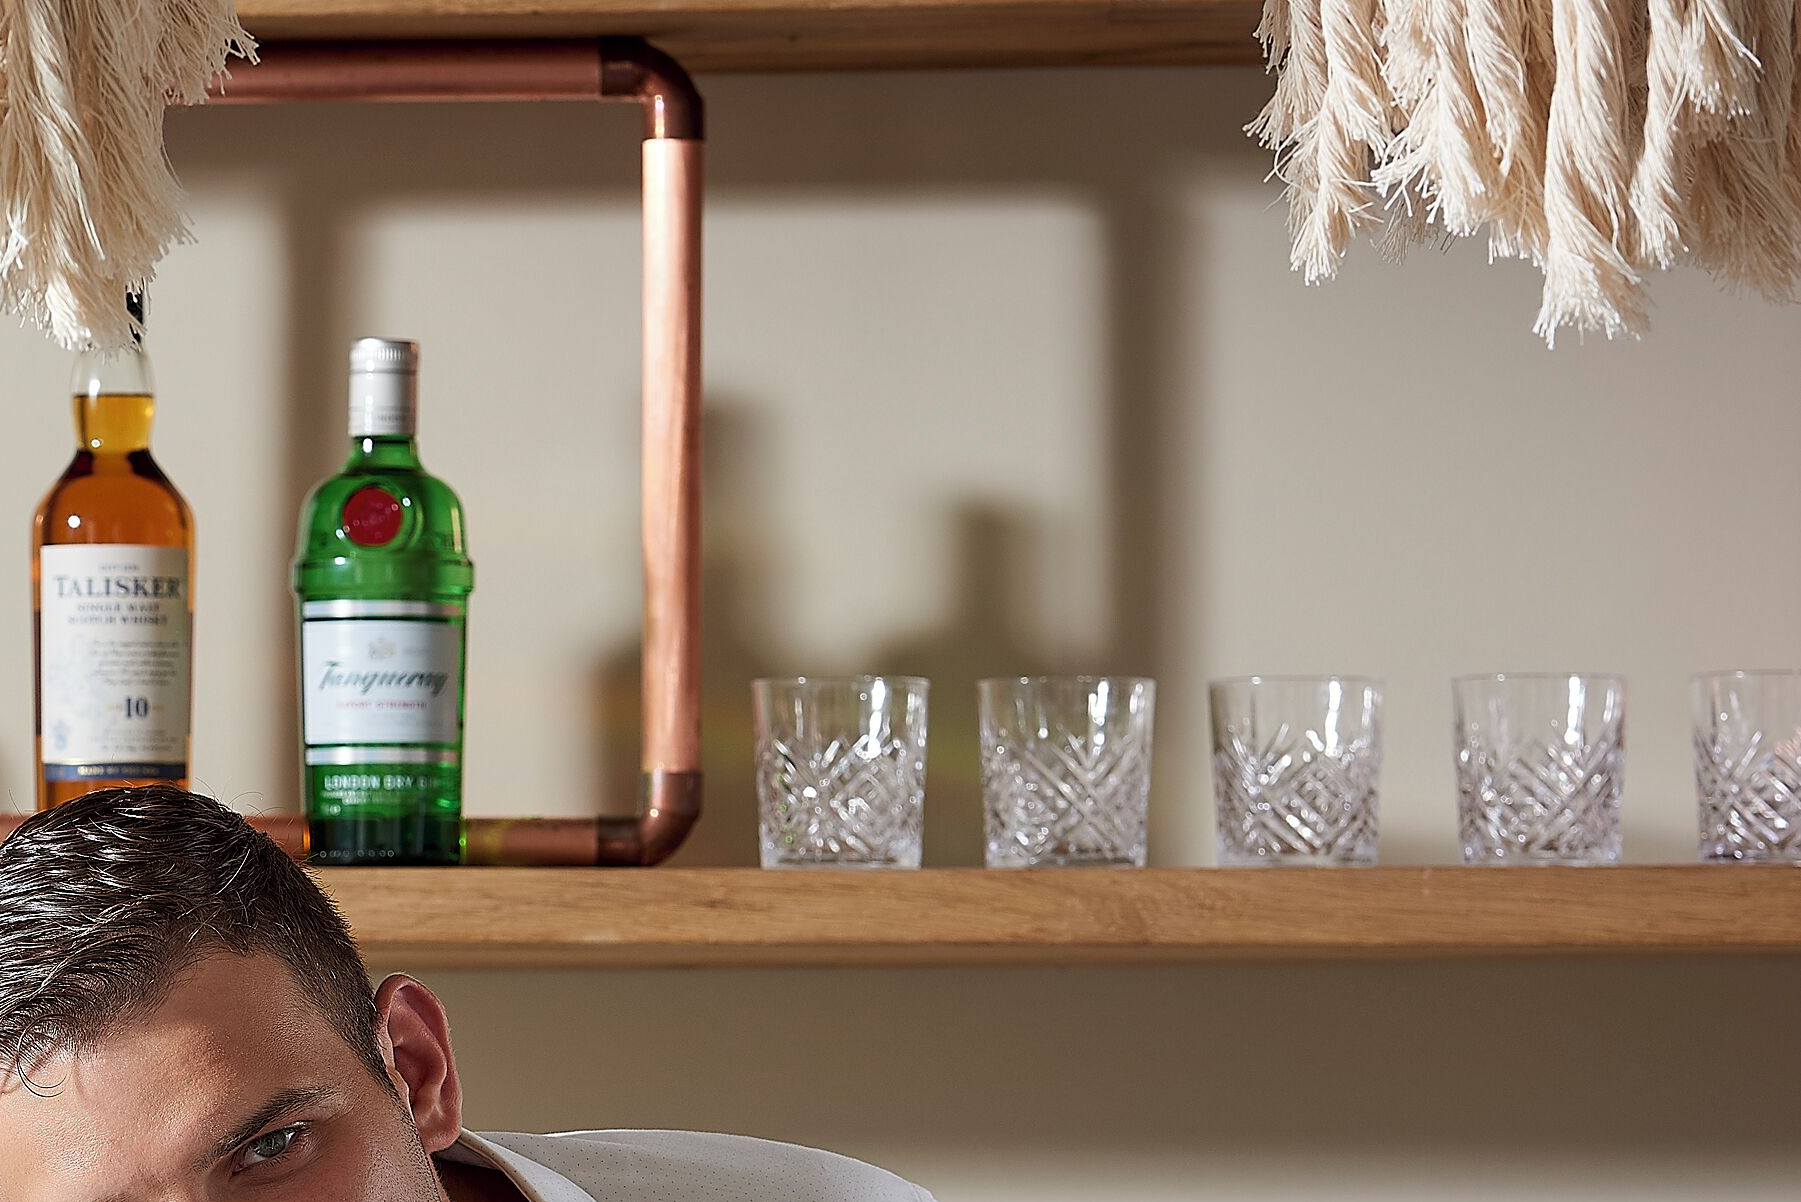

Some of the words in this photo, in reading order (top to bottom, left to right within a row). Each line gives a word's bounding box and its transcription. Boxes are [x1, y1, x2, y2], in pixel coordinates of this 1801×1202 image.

[55, 575, 181, 599] TALISKER
[318, 661, 448, 698] Tanqueray
[125, 695, 149, 719] 10
[324, 775, 380, 791] LONDON
[383, 774, 414, 790] DRY
